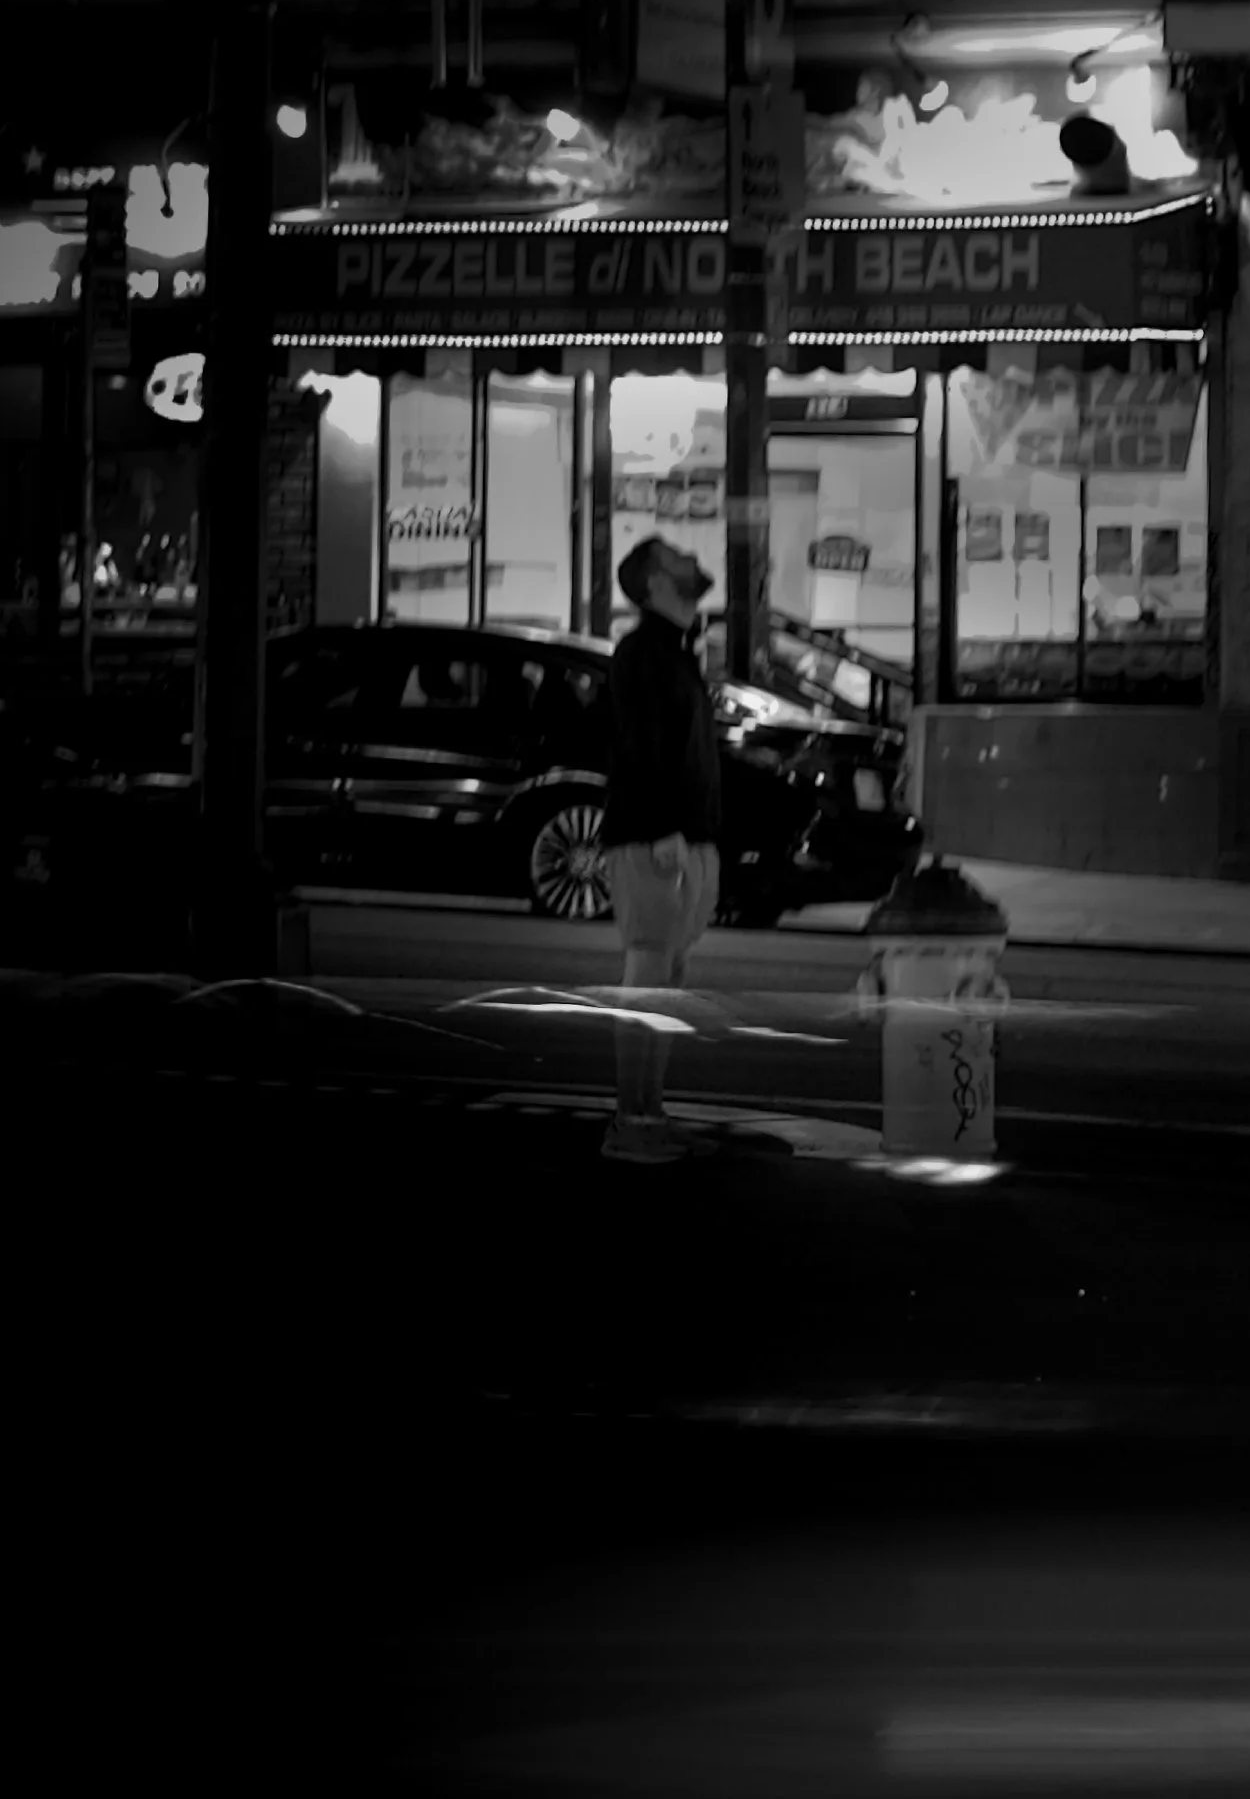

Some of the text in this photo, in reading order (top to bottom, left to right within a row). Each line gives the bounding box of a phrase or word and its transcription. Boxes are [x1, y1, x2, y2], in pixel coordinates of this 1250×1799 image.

[336, 238, 577, 299] PIZZELLE
[643, 235, 833, 295] NOTH
[855, 233, 1040, 293] BEACH
